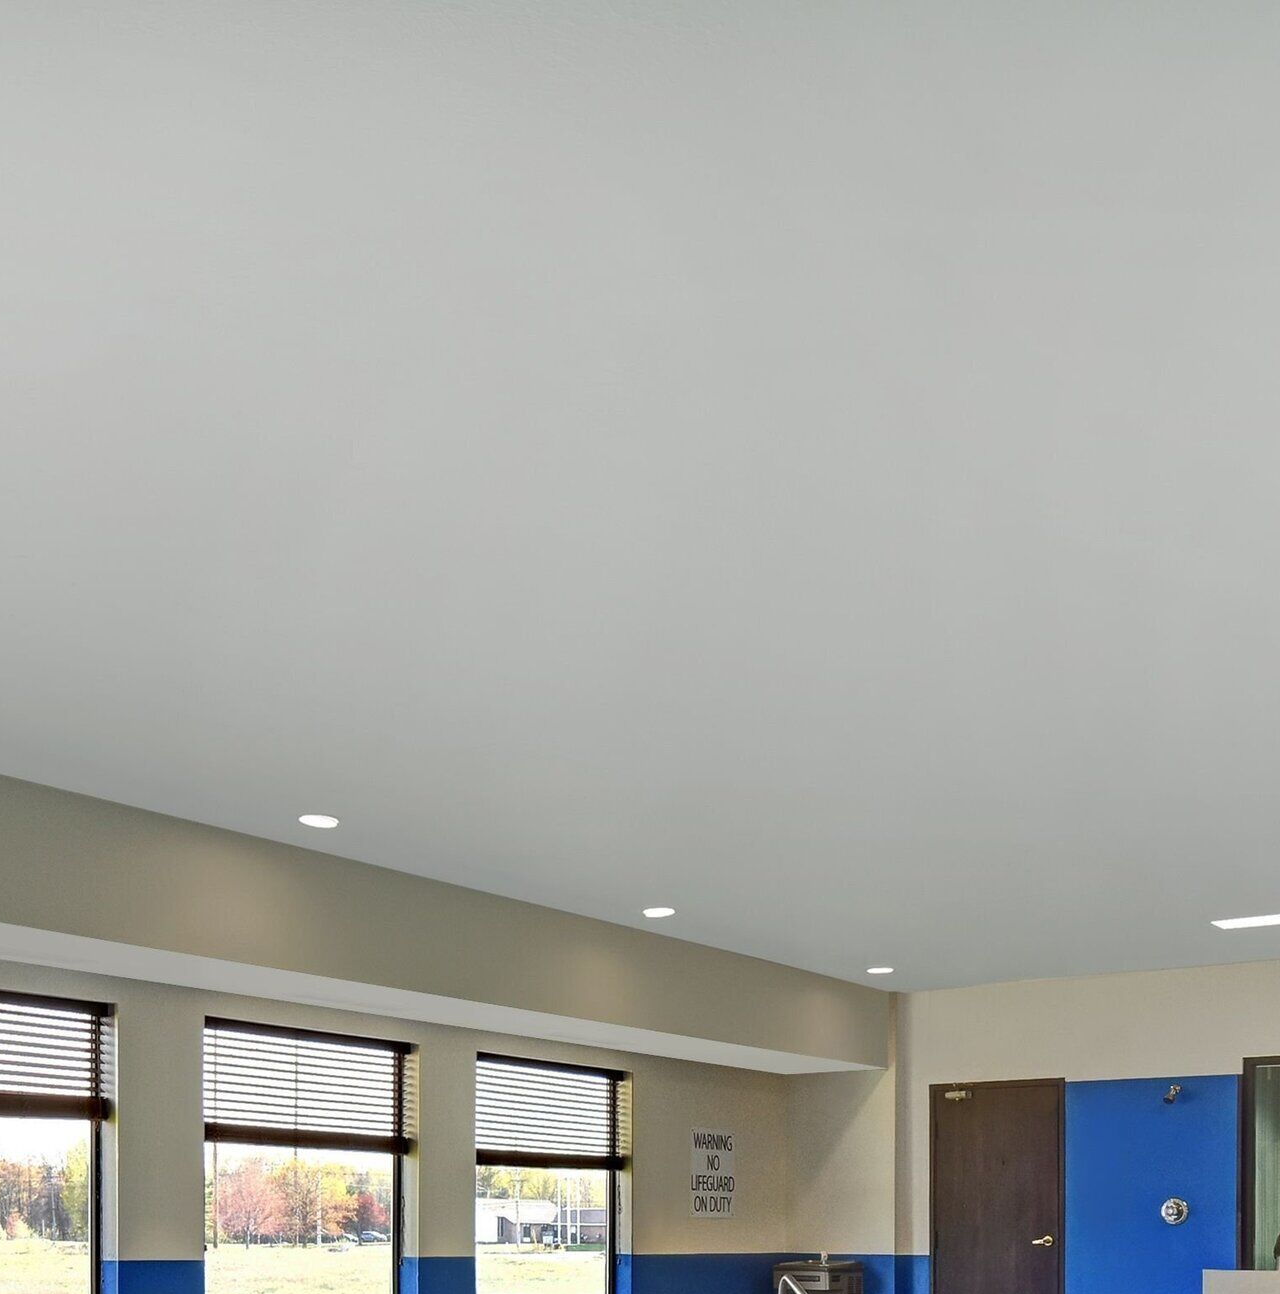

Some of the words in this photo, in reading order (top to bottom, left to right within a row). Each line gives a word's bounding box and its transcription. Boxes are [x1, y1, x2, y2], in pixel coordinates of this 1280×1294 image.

[693, 1132, 733, 1151] WARNING
[707, 1154, 720, 1171] NO
[691, 1174, 735, 1193] LIFEGUARD
[694, 1195, 707, 1212] ON
[710, 1196, 732, 1213] DUTY
